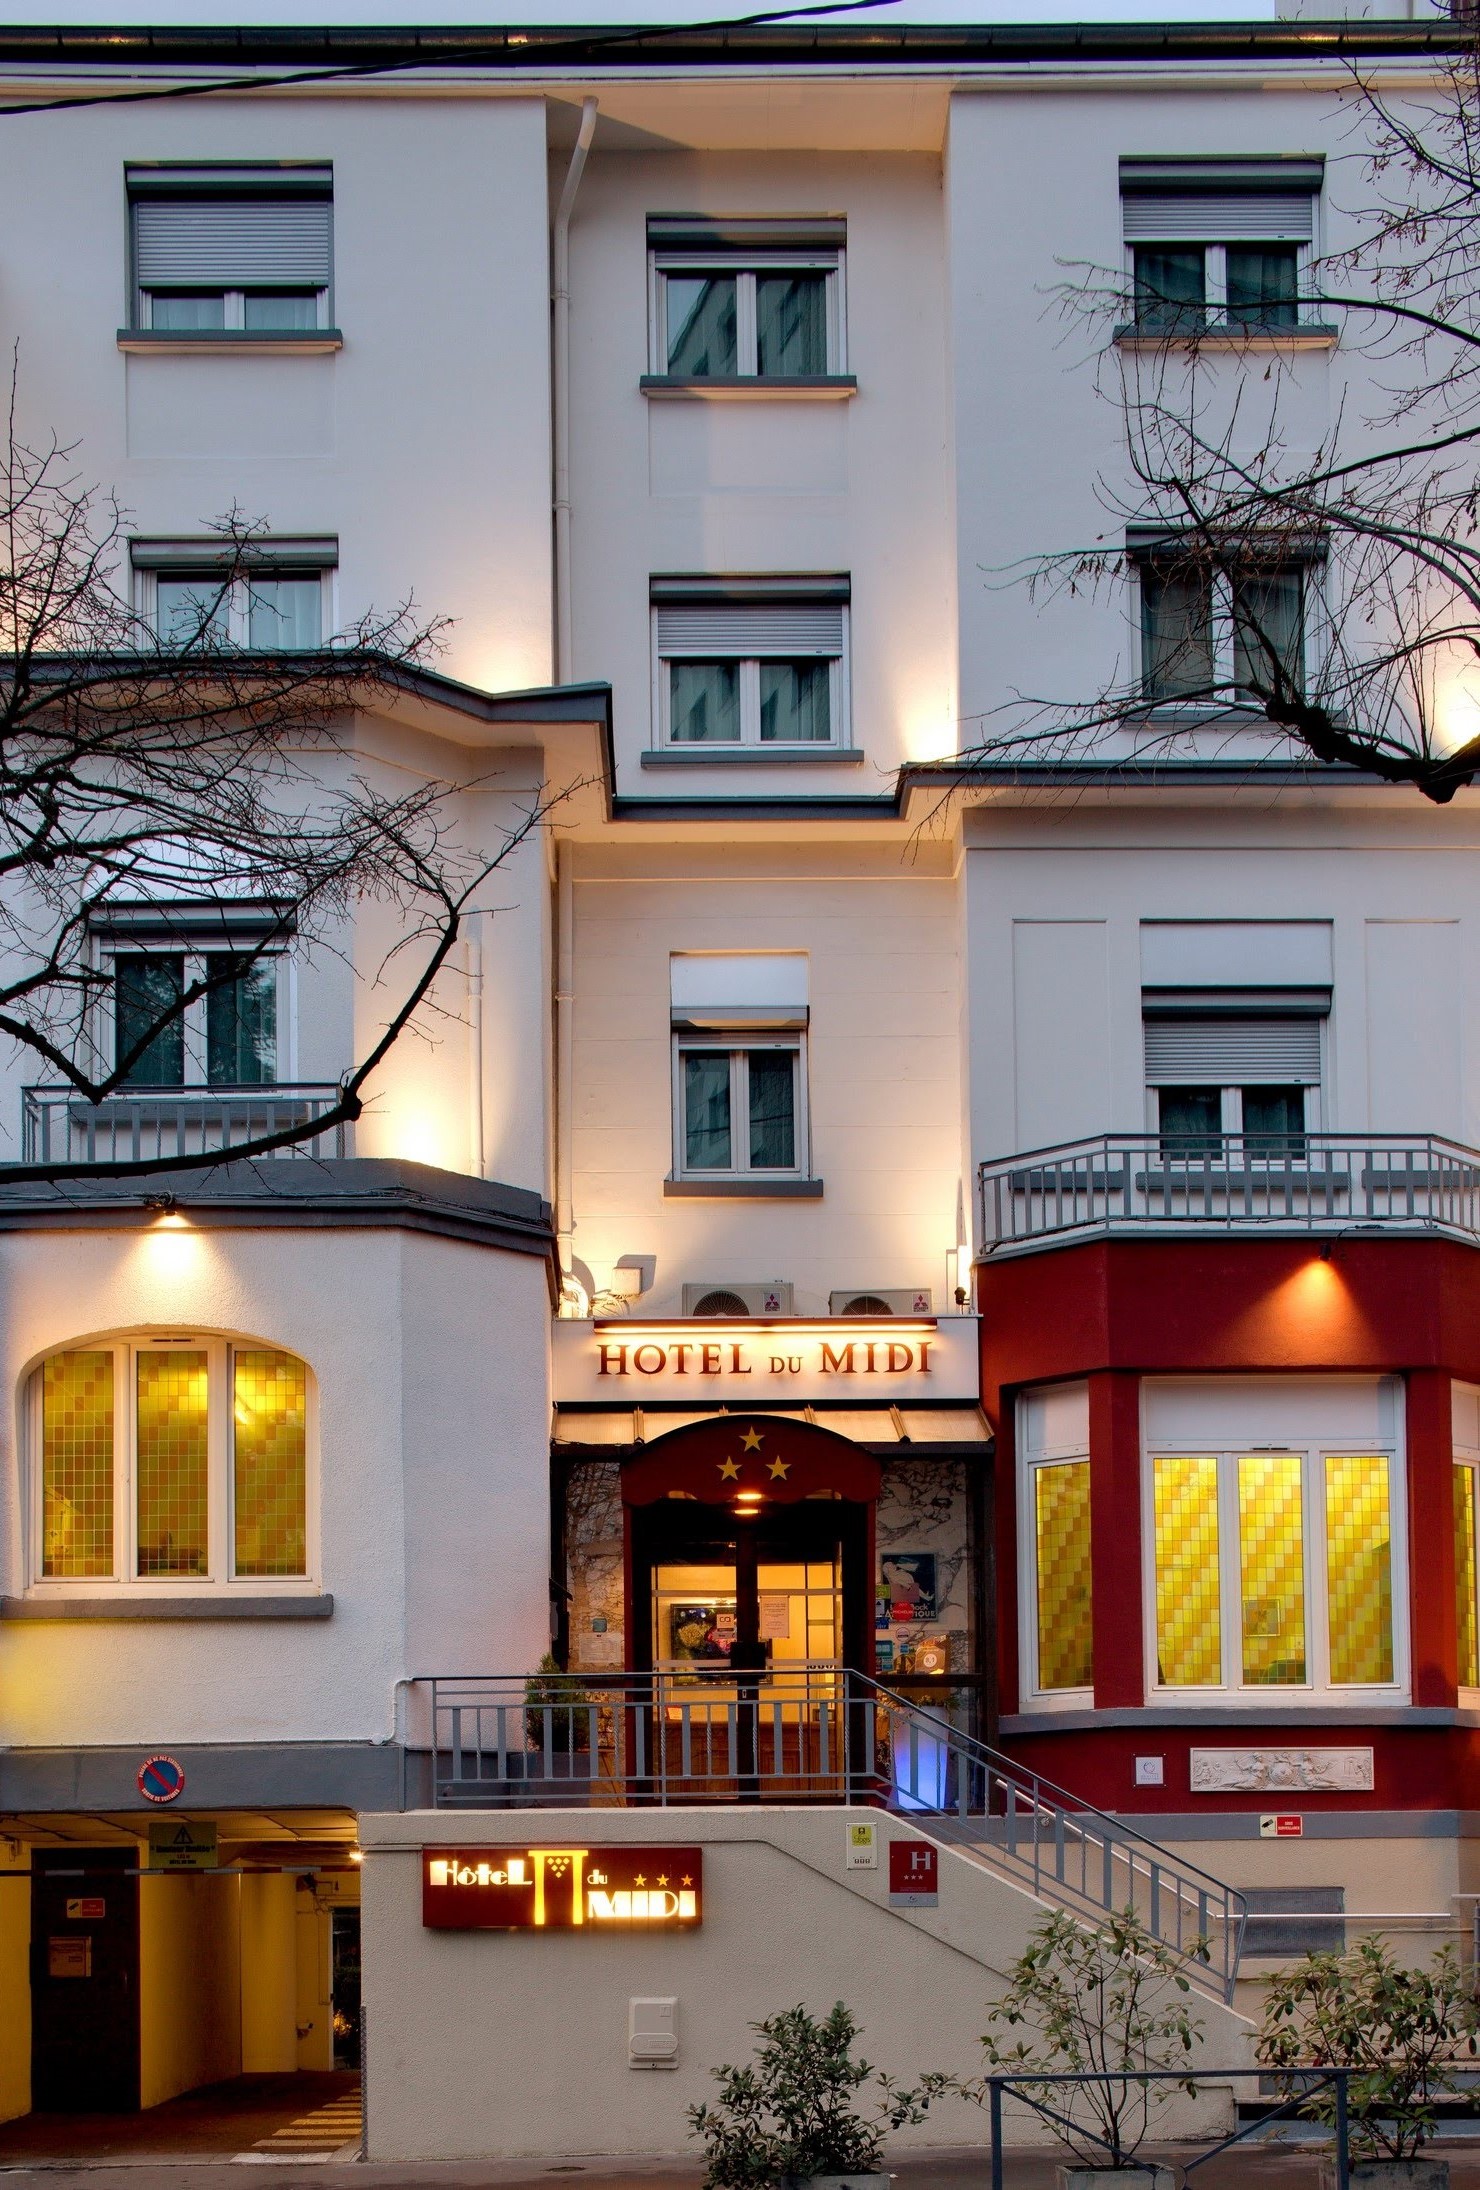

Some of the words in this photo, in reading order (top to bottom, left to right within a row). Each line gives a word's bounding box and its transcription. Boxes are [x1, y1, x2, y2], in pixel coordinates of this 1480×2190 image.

[597, 1343, 752, 1376] HOTEL
[768, 1356, 802, 1374] DU
[818, 1341, 933, 1374] MIDI
[910, 1851, 932, 1870] H
[587, 1869, 608, 1885] du
[587, 1890, 697, 1919] MIDI
